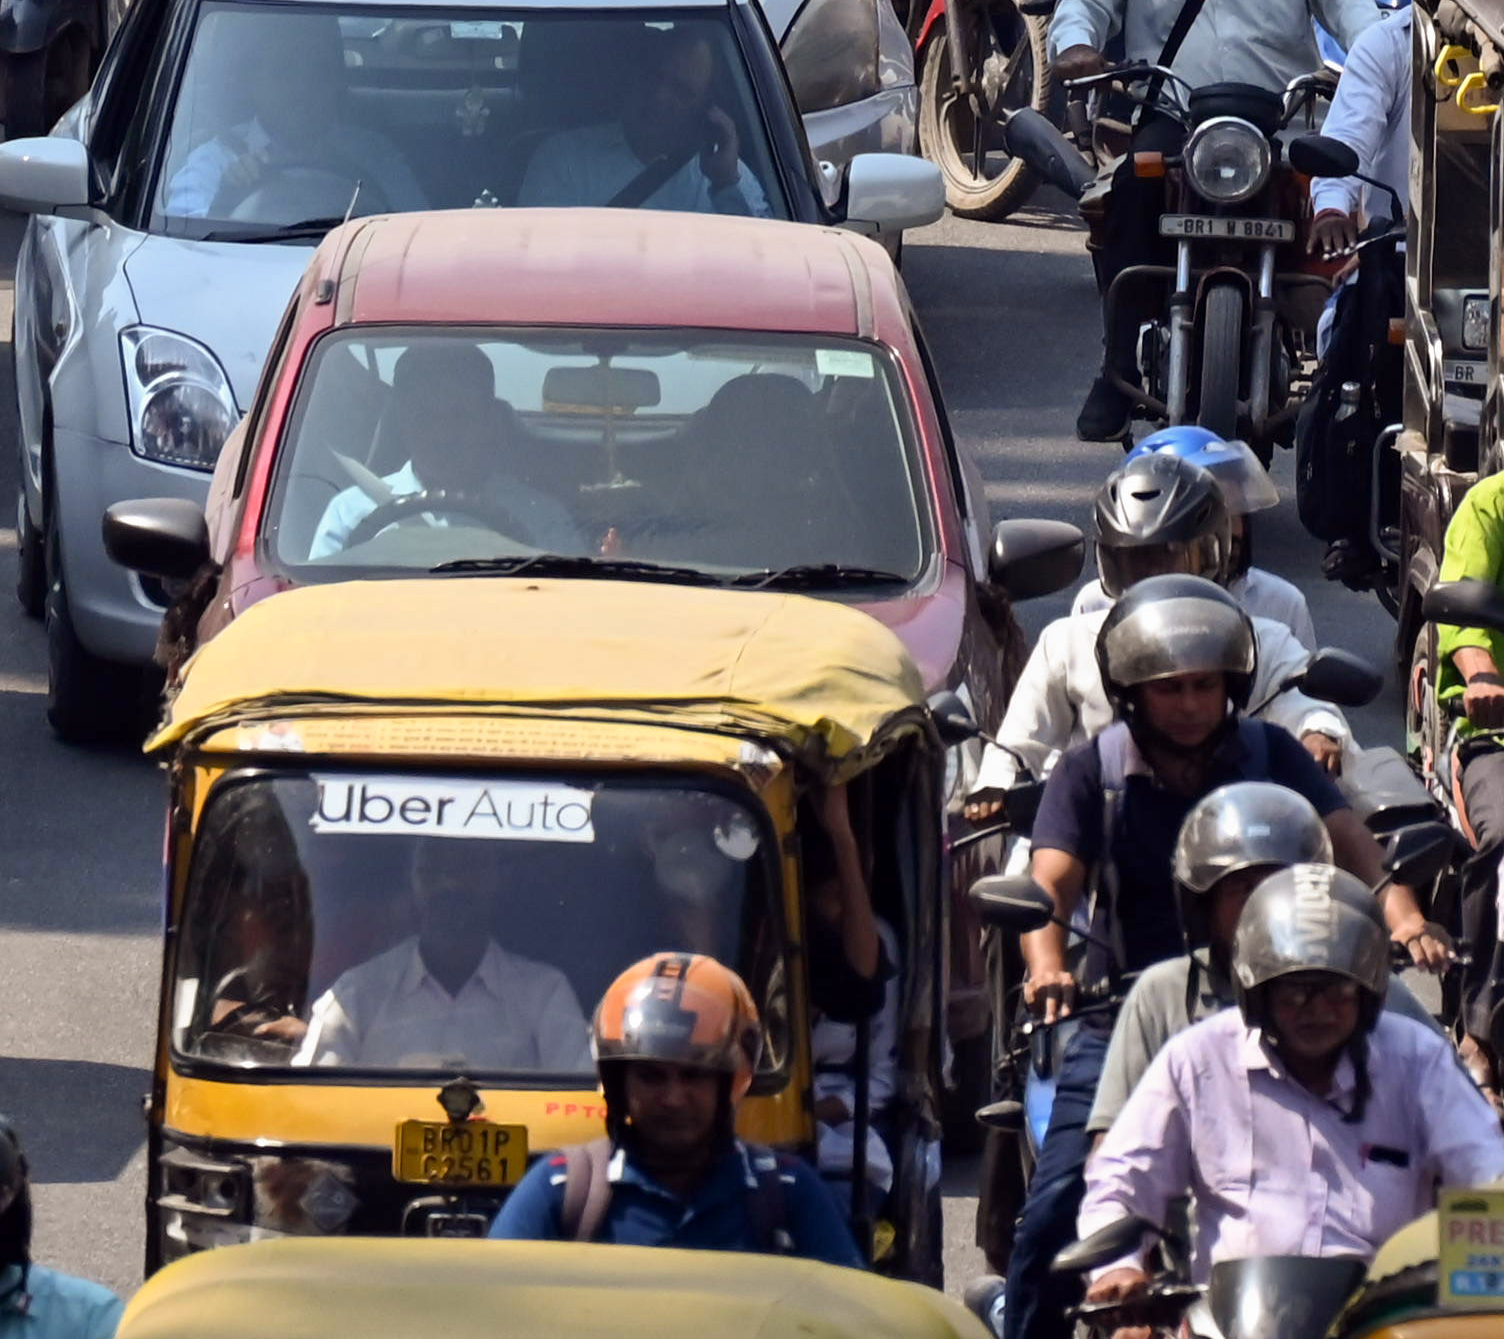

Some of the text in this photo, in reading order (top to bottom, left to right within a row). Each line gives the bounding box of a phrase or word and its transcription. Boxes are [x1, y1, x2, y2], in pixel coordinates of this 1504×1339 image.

[317, 784, 590, 832] Uber Auto
[423, 1126, 510, 1155] BR01P
